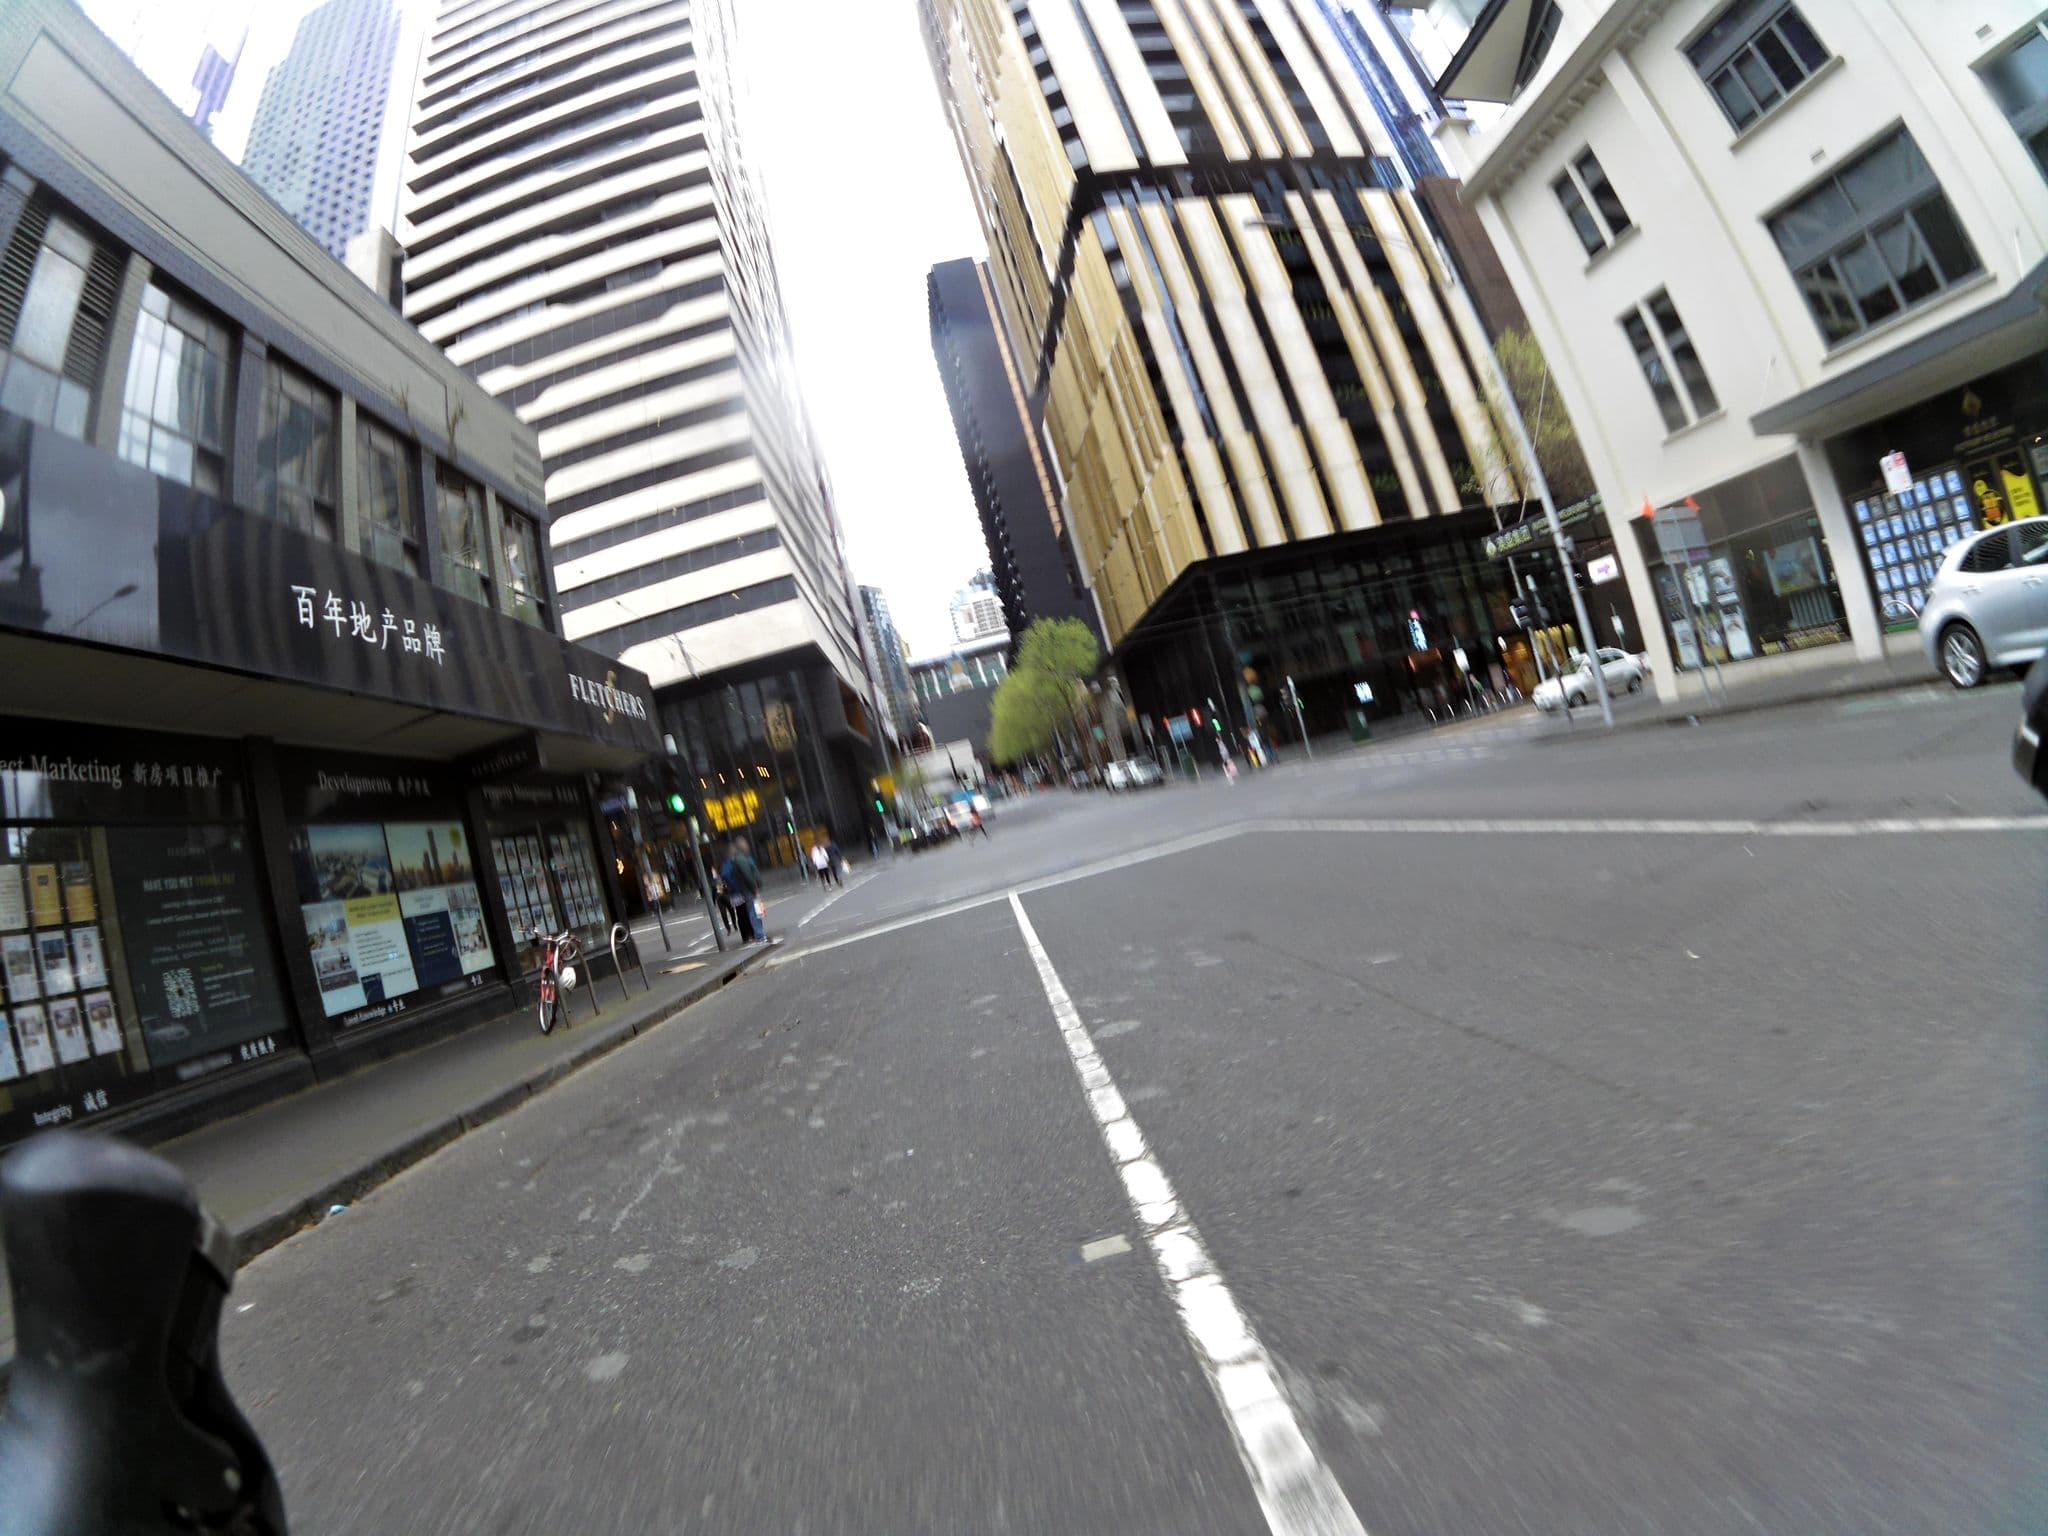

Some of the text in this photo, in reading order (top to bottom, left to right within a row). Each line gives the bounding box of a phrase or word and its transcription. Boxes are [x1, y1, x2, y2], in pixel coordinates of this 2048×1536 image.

[291, 585, 446, 666] 百年地产品牌
[569, 673, 647, 721] FLETCHERS
[31, 754, 122, 789] Marketing
[318, 768, 393, 798] Developments
